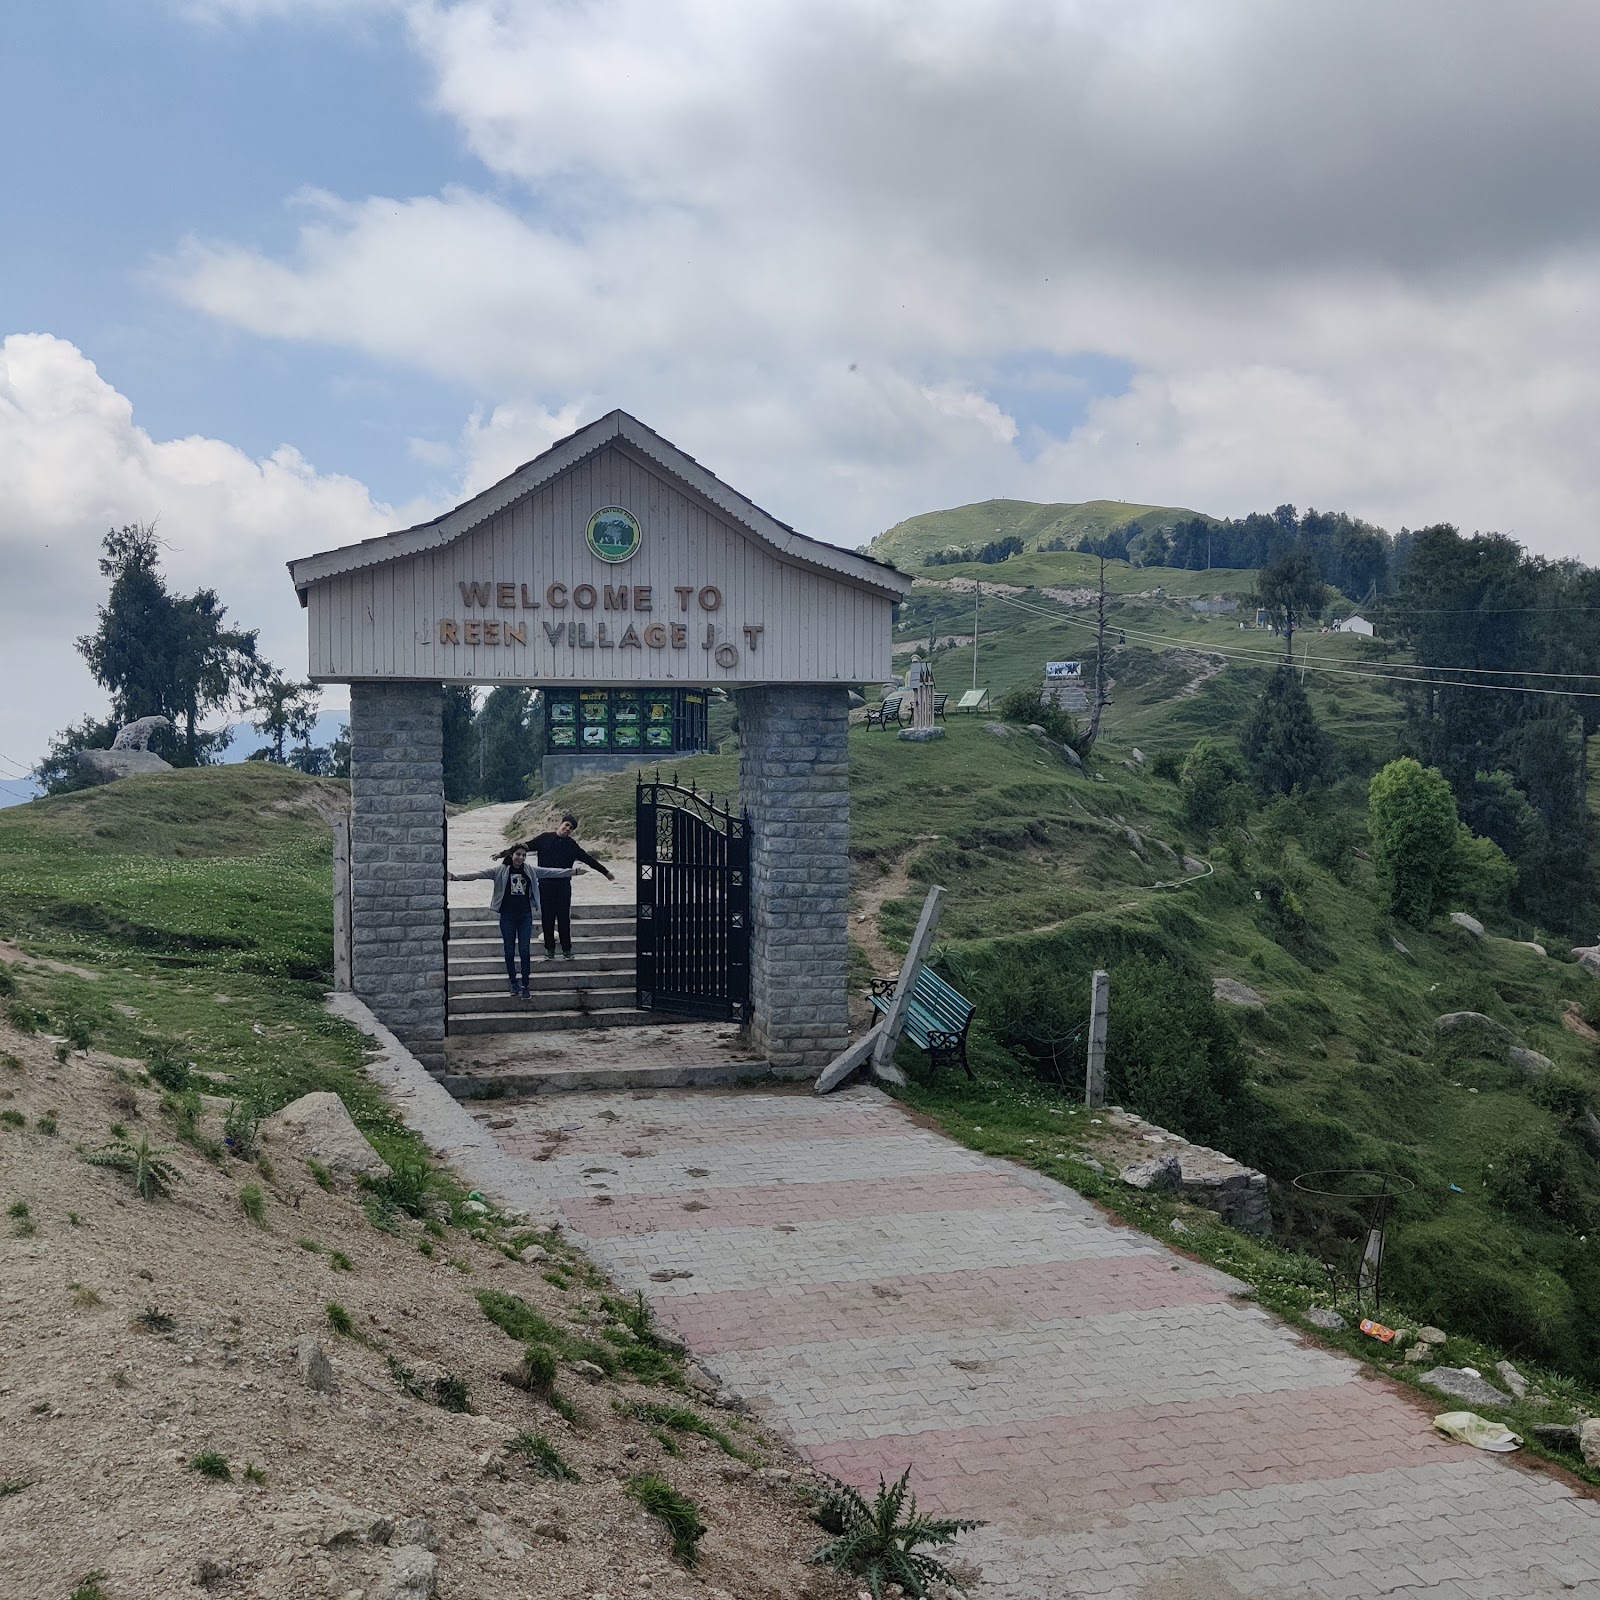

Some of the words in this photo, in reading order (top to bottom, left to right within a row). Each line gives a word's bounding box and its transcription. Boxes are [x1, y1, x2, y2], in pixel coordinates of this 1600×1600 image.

[624, 512, 636, 524] PARK
[459, 581, 652, 611] WELCOME
[675, 585, 722, 612] TO
[439, 618, 527, 647] REEN
[542, 621, 687, 649] VILLAGE
